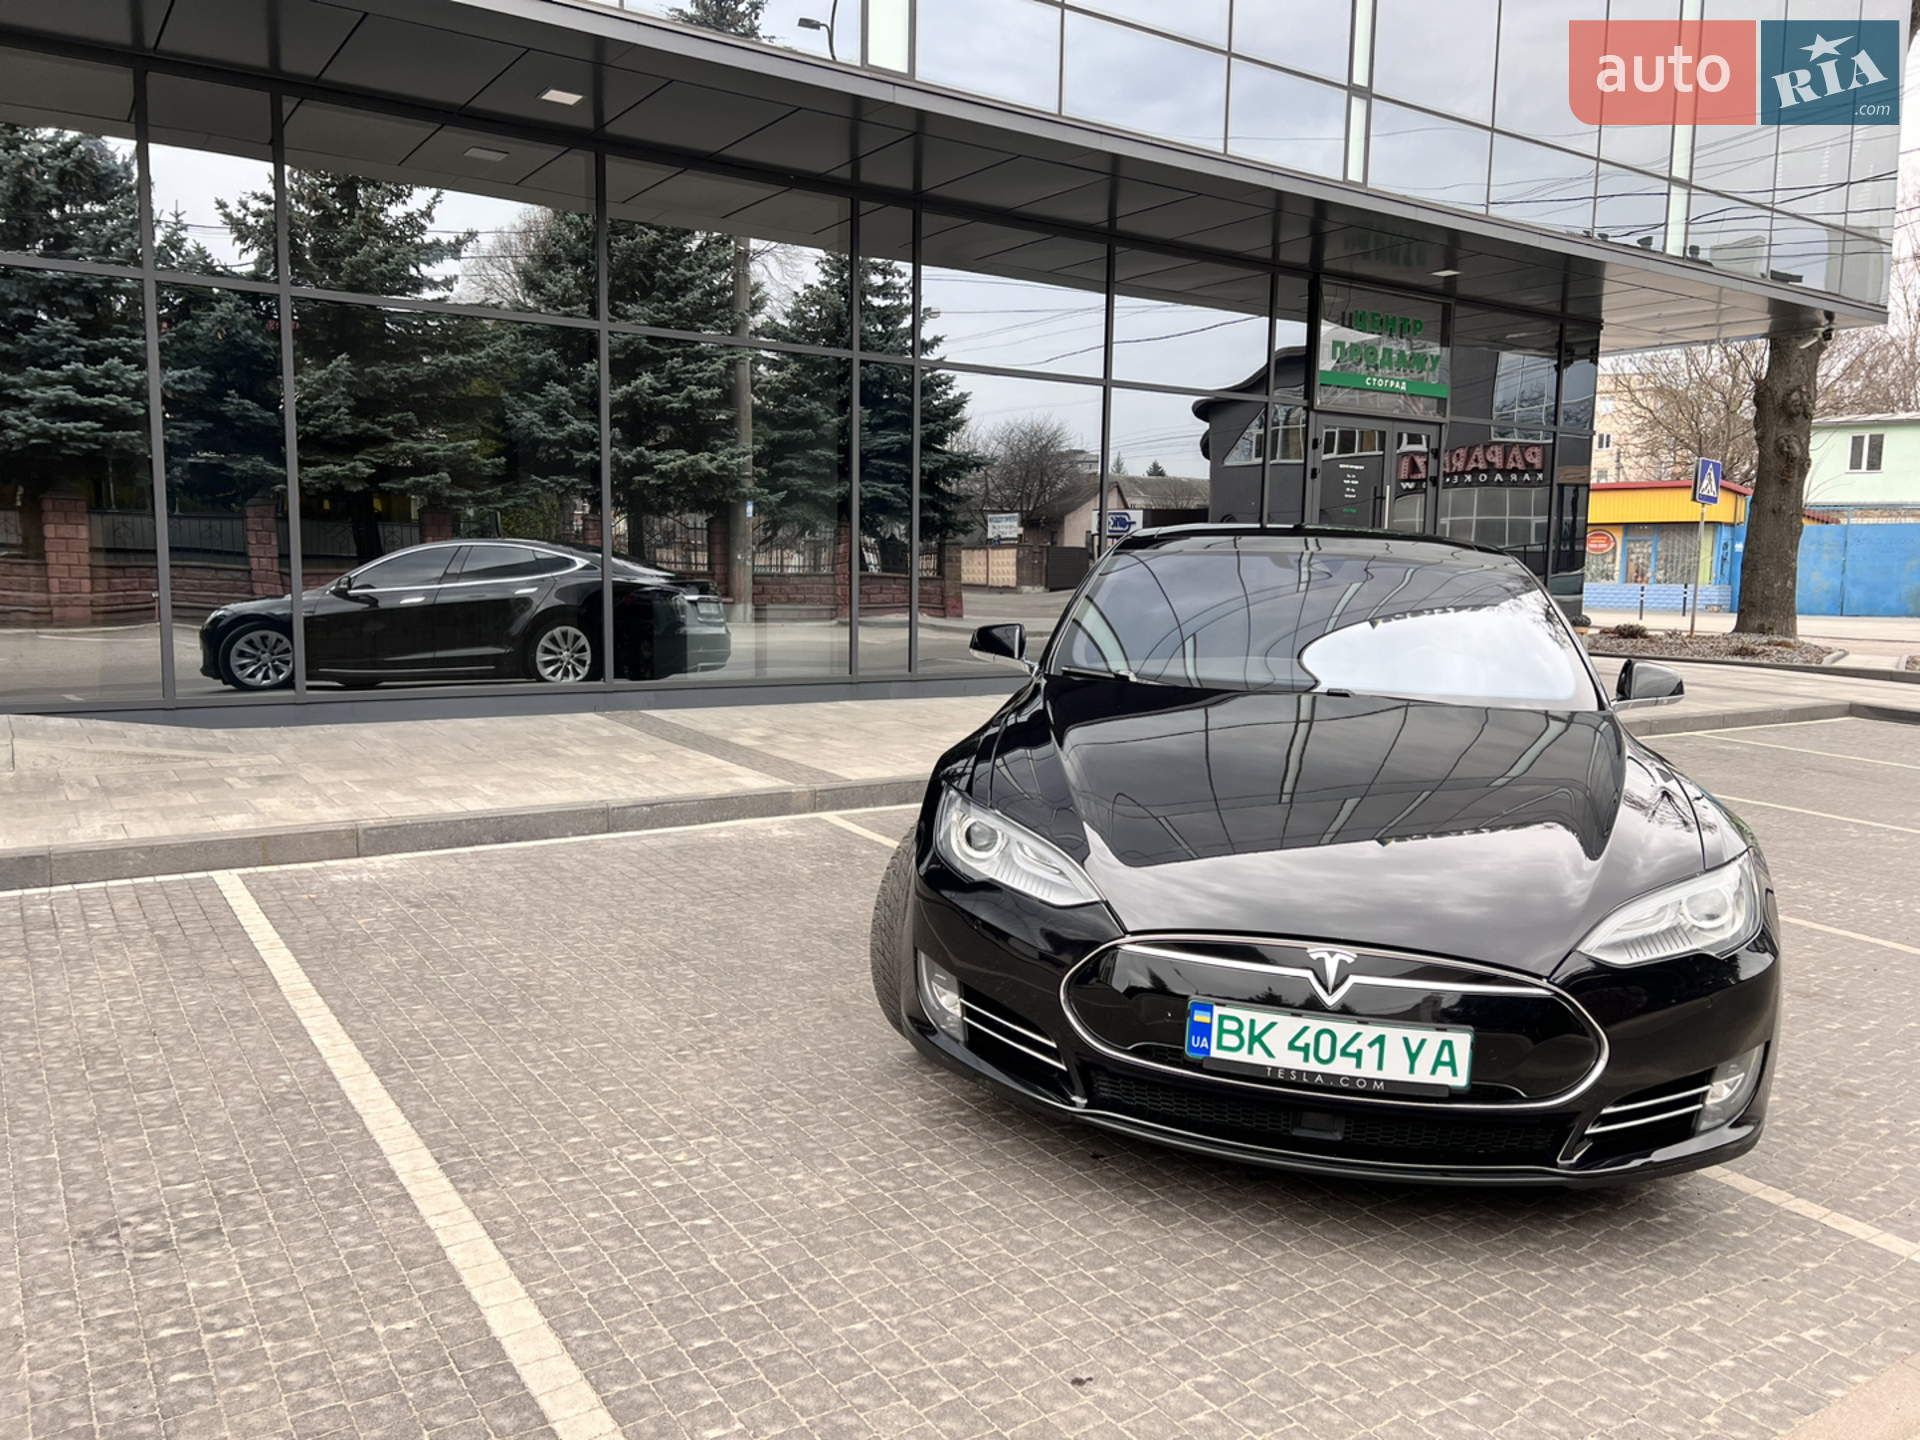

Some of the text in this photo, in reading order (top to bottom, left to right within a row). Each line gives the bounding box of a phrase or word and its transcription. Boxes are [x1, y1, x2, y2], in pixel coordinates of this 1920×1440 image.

[1354, 309, 1425, 337] ЦЕНТР
[1331, 340, 1441, 372] ПРОДАЖУ
[1365, 376, 1407, 391] СТОГРАД
[1191, 1035, 1209, 1050] UA
[1216, 1013, 1459, 1078] BK 4041 YA
[1266, 1066, 1386, 1091] TESLA.COM
